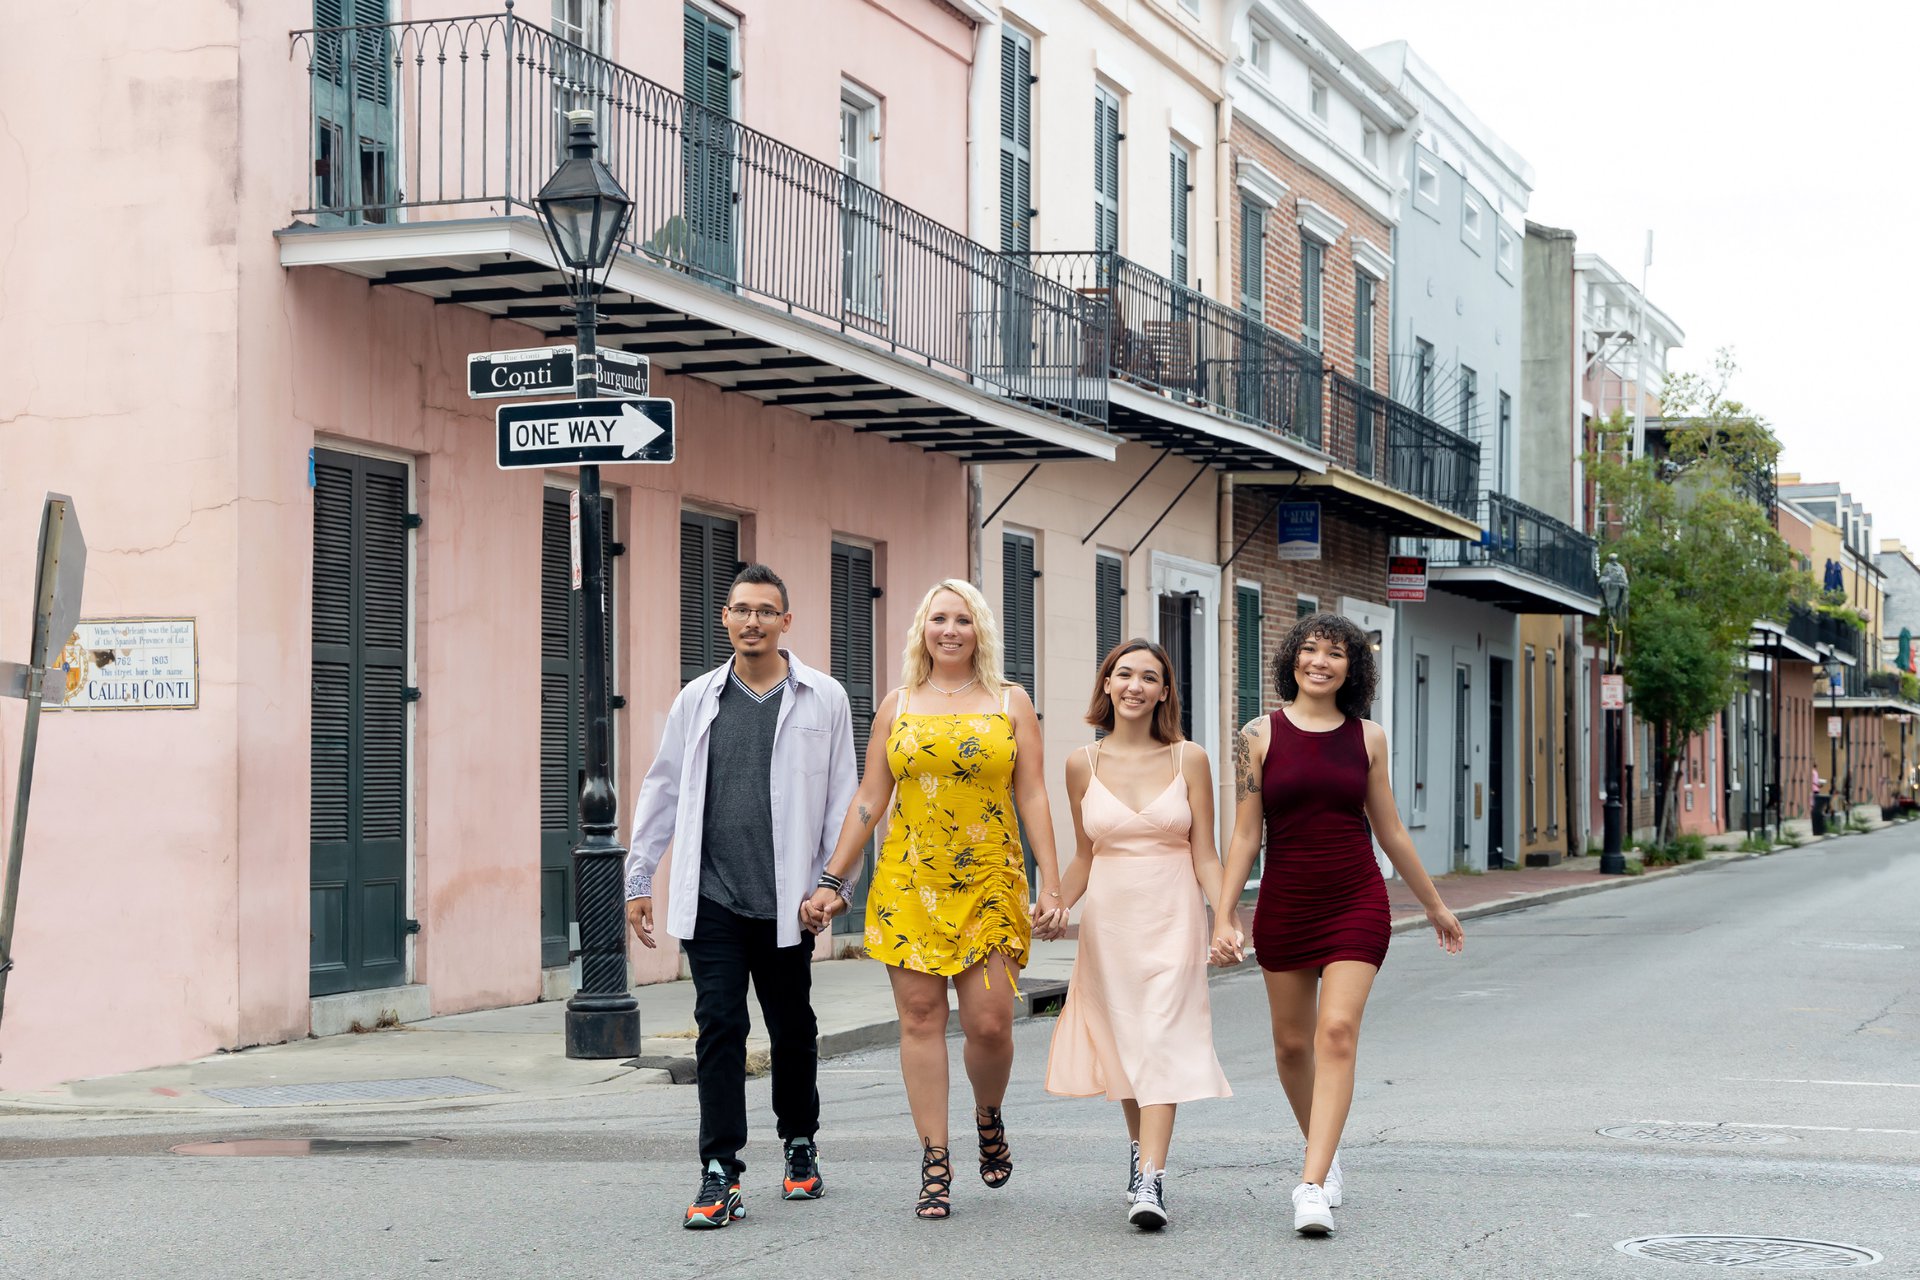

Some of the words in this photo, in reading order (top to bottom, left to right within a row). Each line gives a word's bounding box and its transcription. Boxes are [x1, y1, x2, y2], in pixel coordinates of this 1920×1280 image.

[520, 352, 540, 360] Conti
[490, 362, 553, 388] Conti
[596, 362, 647, 393] Burgundy
[516, 422, 559, 448] ONE
[568, 419, 617, 444] WAY
[1391, 566, 1424, 575] RENT
[1389, 590, 1424, 599] COURTYARD
[94, 626, 110, 636] When
[160, 625, 168, 634] the
[170, 624, 189, 636] Capital
[94, 638, 100, 646] of
[103, 638, 113, 646] the
[115, 637, 137, 647] Spanish
[139, 636, 164, 645] Province
[167, 636, 173, 645] of
[151, 655, 169, 665] 1803
[101, 668, 113, 676] This
[152, 667, 162, 676] the
[167, 668, 183, 676] name
[89, 680, 128, 700] CALLE
[144, 679, 189, 699] CONTI
